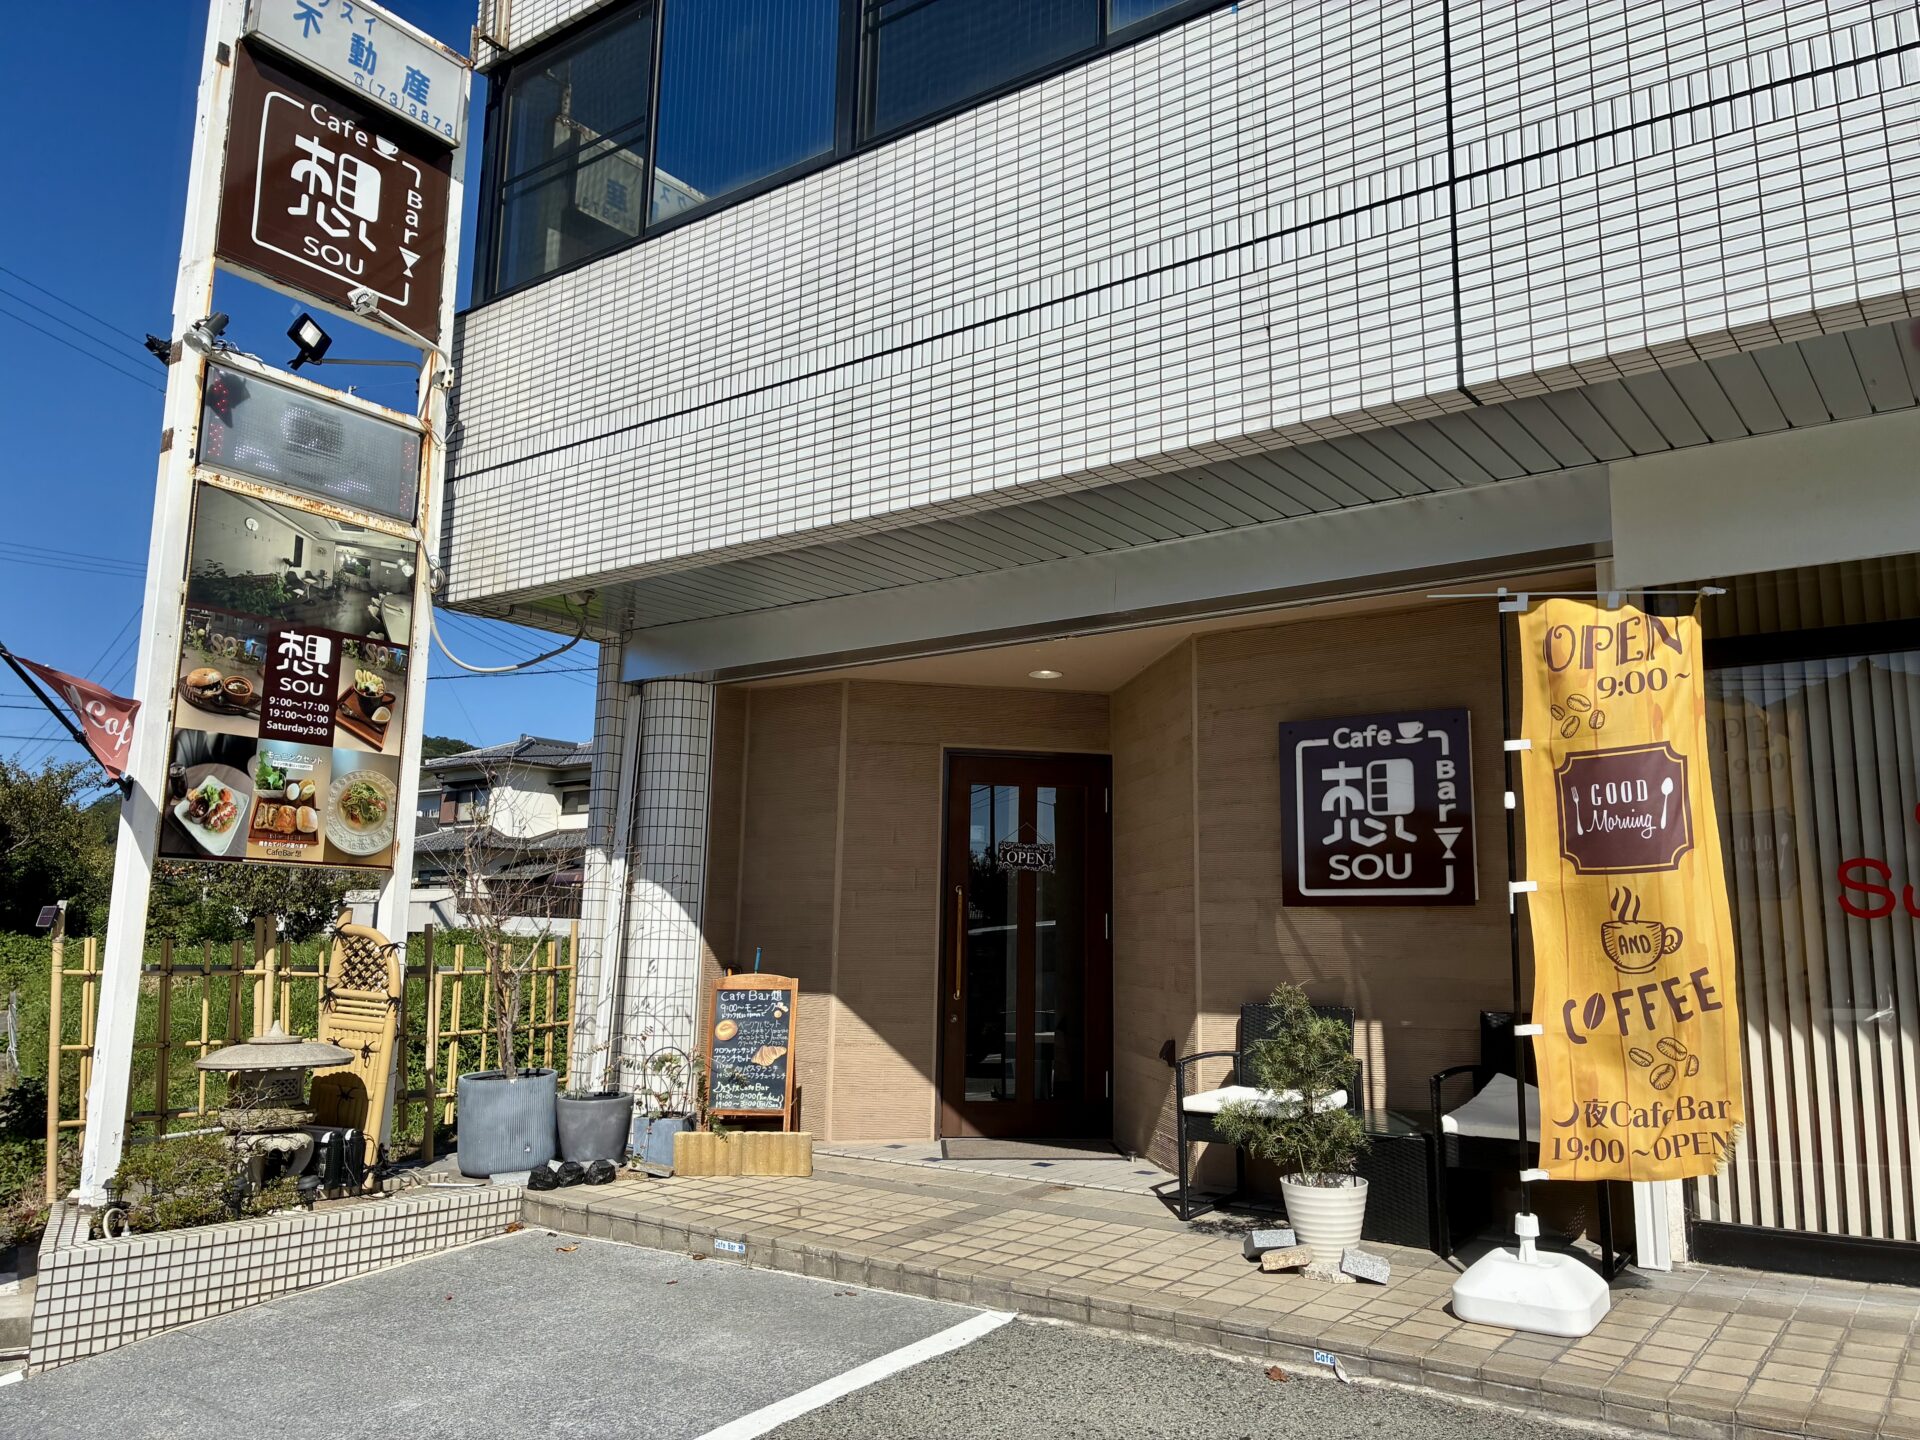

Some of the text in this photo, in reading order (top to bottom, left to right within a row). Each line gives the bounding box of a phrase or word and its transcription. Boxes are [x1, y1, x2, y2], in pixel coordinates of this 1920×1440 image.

[318, 0, 376, 36] スイ
[310, 103, 368, 148] Cafe
[287, 134, 382, 252] 想
[403, 188, 423, 244] Bar
[303, 235, 365, 276] SOU
[276, 630, 332, 678] 想
[1542, 613, 1684, 673] OPEN
[279, 677, 324, 696] SOU
[1332, 724, 1393, 749] Cafe
[1321, 757, 1418, 848] 想
[1435, 759, 1457, 822] Bar
[1590, 779, 1649, 806] GOOD
[1586, 808, 1657, 839] Morning
[1006, 850, 1046, 865] OPEN
[1328, 853, 1412, 881] SOU
[1618, 933, 1652, 956] AND
[720, 991, 746, 1002] Cafe
[1562, 966, 1724, 1045] COFFEE
[1315, 1351, 1335, 1364] Cafe
